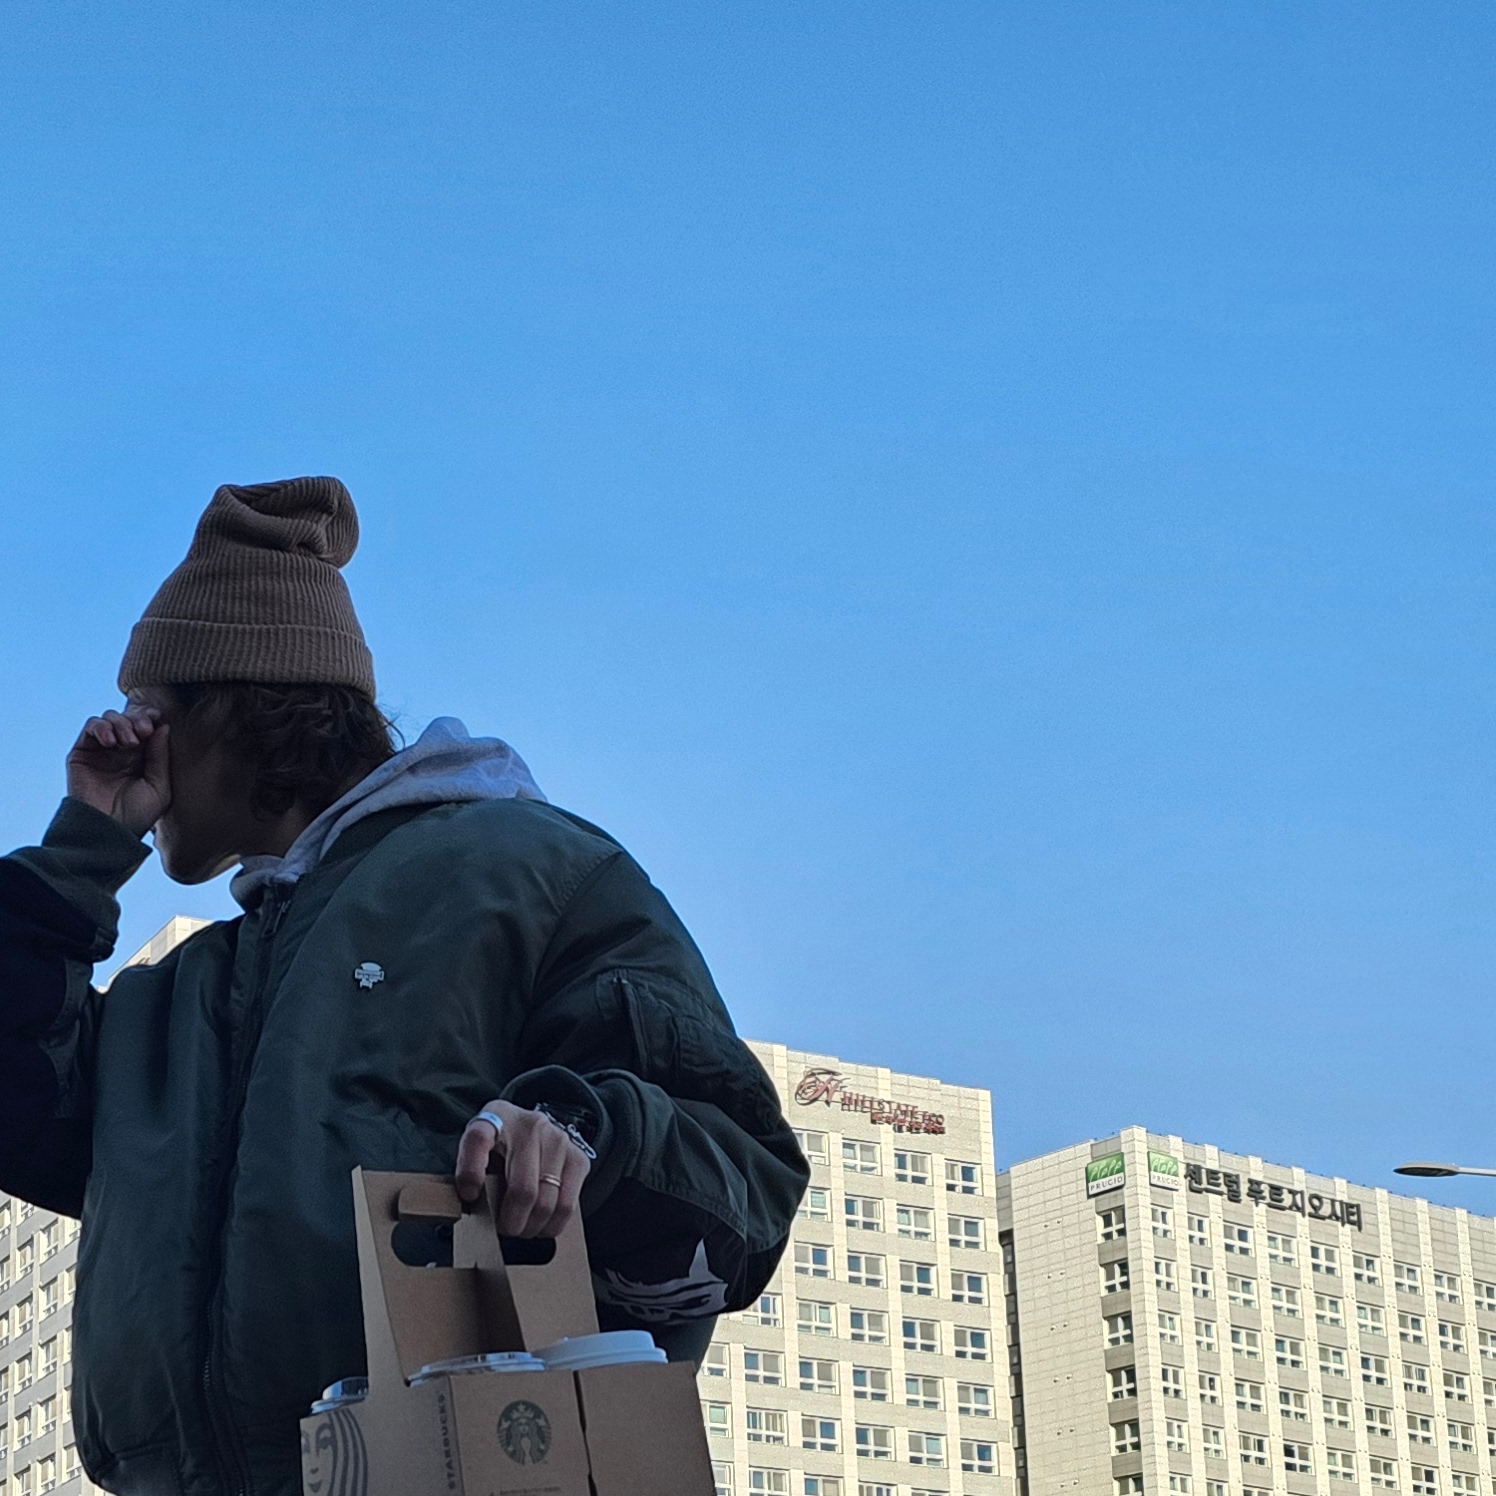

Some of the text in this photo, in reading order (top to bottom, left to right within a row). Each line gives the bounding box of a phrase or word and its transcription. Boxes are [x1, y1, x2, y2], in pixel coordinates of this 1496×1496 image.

[1090, 1175, 1123, 1192] PRUGIO
[1152, 1174, 1179, 1186] PRUGIO
[1183, 1162, 1363, 1232] 센트럴 푸르지오시티
[438, 1394, 456, 1490] STARBUCKS
